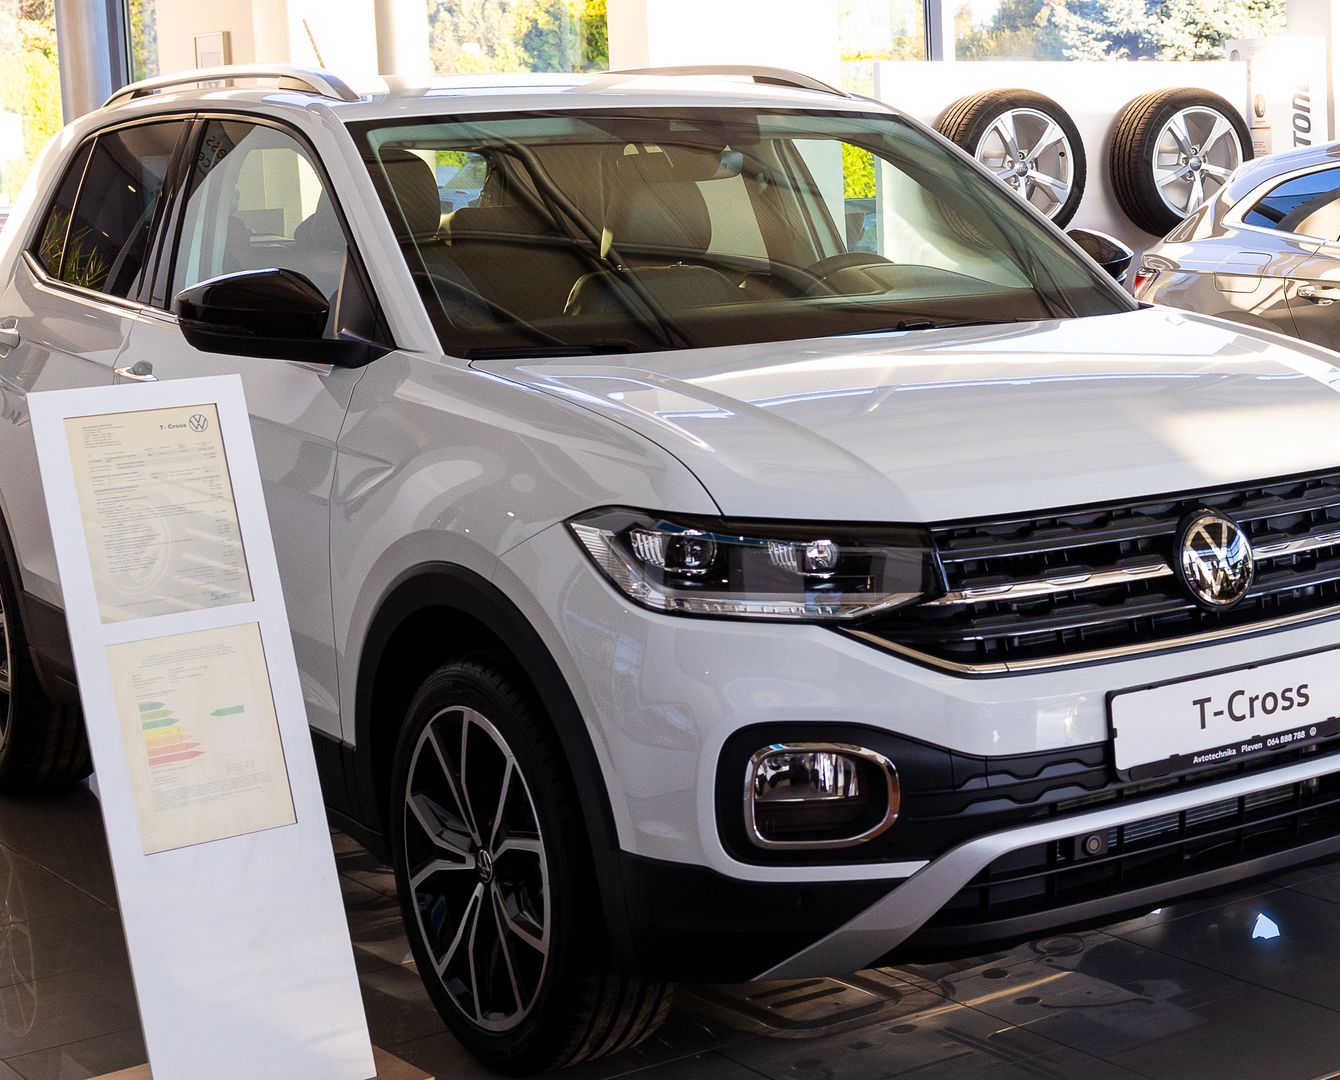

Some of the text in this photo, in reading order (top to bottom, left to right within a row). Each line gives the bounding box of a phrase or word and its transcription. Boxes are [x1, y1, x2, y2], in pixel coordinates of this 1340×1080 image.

[1192, 683, 1310, 730] T-Cross
[1193, 748, 1237, 764] Avtotechnika
[1241, 742, 1263, 753] Pleven
[1267, 737, 1279, 746] 064
